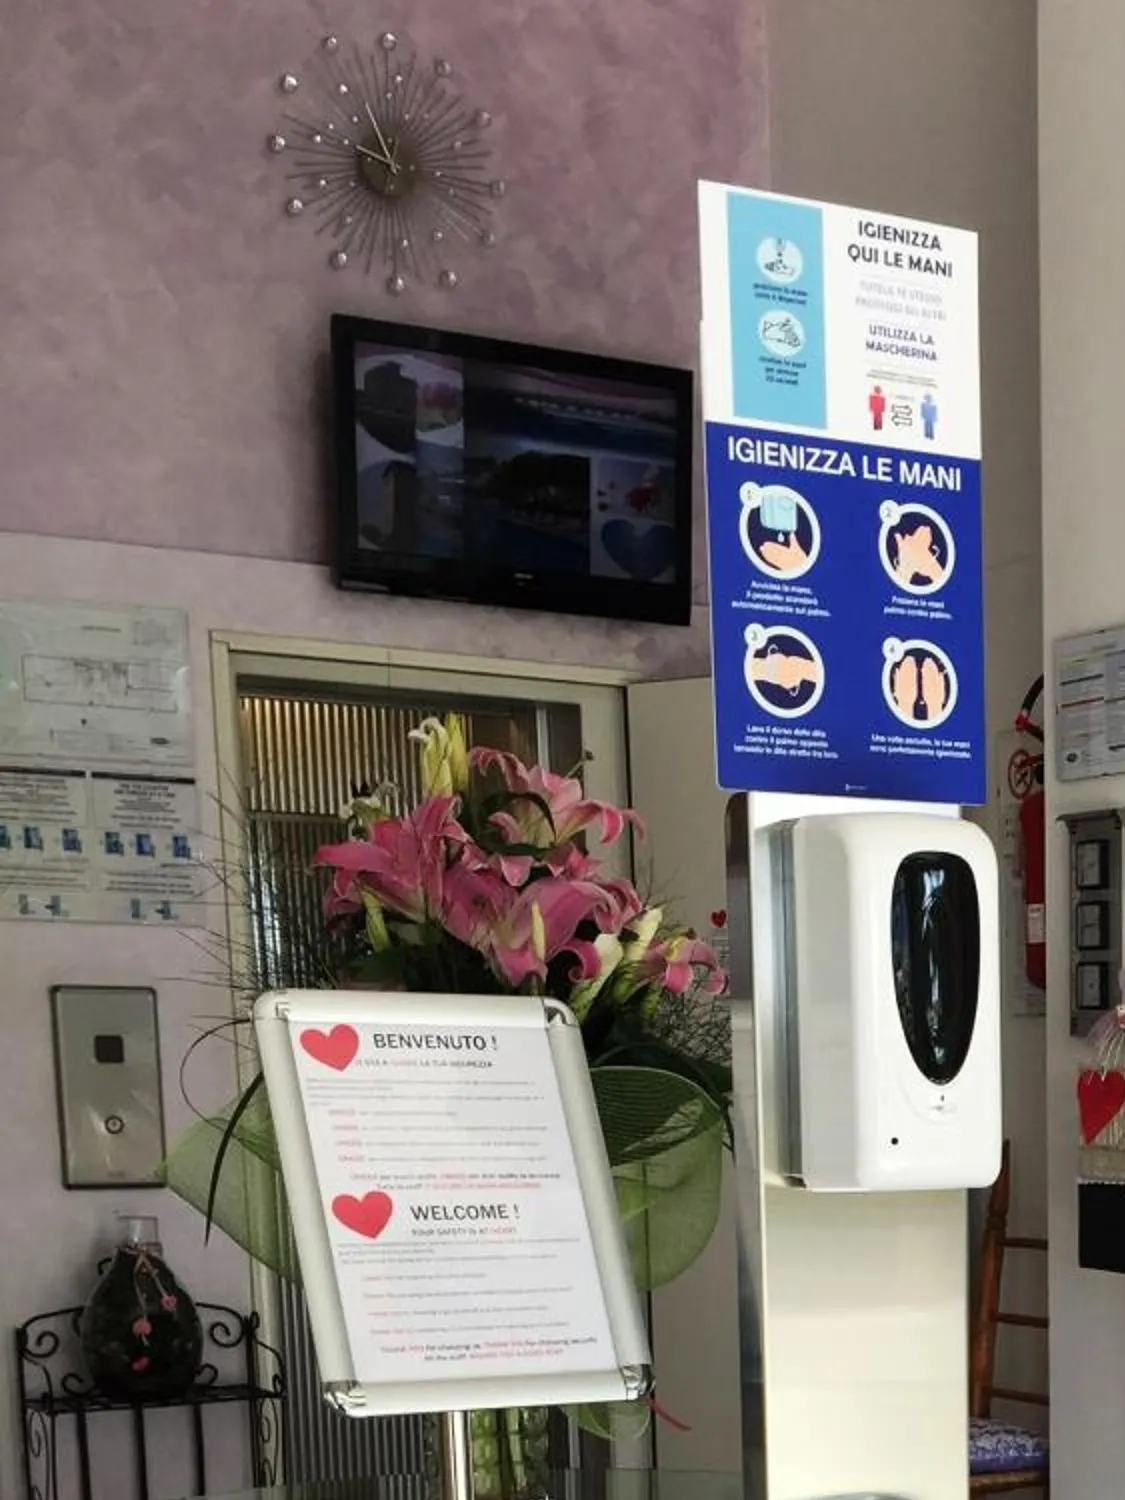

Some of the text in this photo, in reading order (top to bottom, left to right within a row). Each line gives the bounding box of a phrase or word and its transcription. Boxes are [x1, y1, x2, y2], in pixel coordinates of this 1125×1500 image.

[858, 220, 942, 252] IGIENIZZA
[847, 243, 953, 278] QUI LE MANI
[868, 323, 935, 345] UTILIZZA LA
[865, 340, 937, 361] MASCHERINA
[728, 436, 961, 491] IGIENIZZA LE MANI
[373, 1033, 498, 1051] BENVENUTO !
[409, 1203, 520, 1221] WELCOME !
